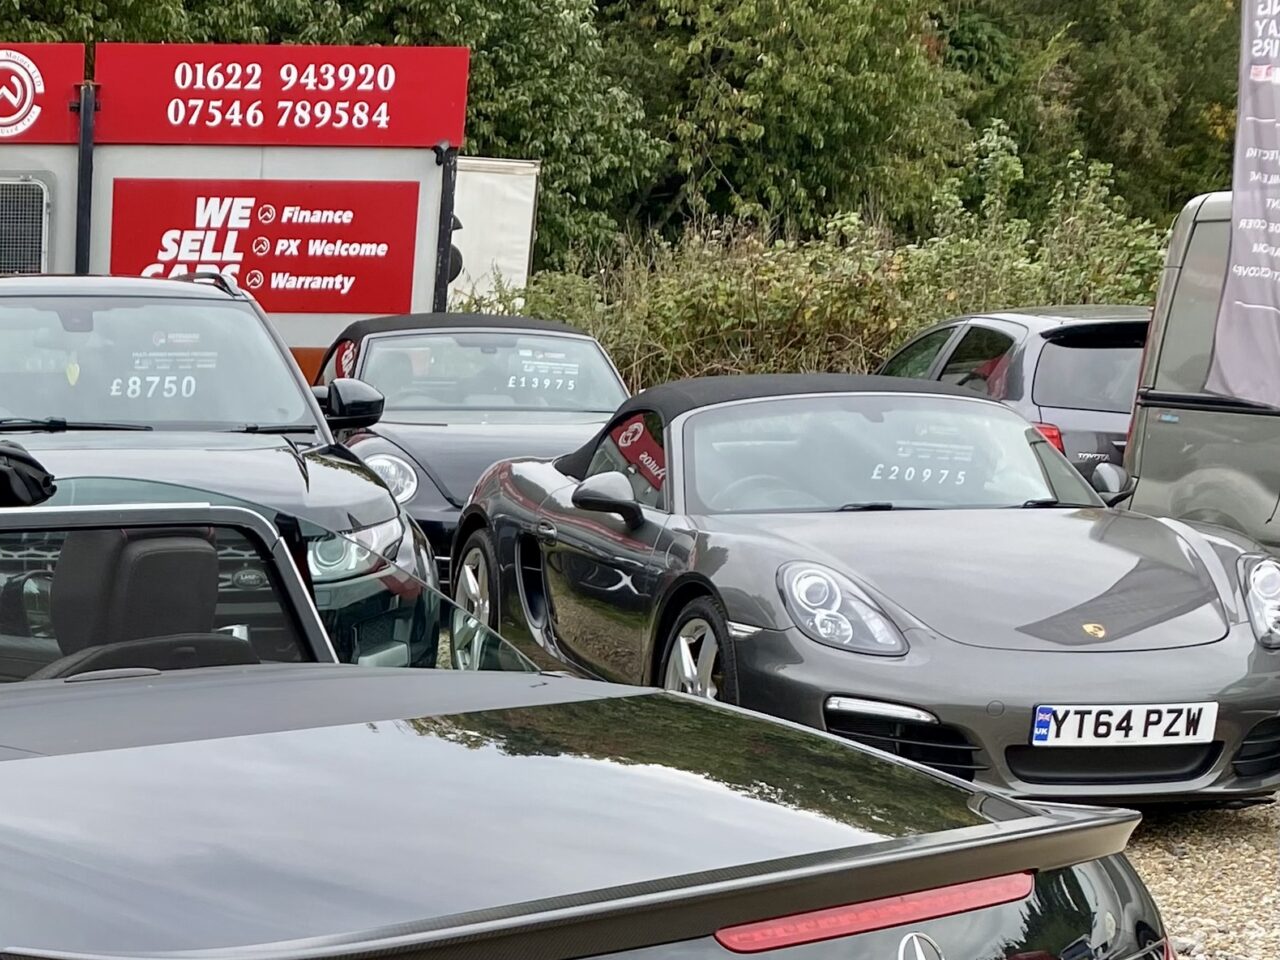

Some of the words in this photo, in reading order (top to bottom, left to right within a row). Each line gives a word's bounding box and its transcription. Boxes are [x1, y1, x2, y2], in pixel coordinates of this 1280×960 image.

[175, 63, 261, 89] 01622
[280, 64, 395, 90] 943920
[168, 99, 263, 127] 07546
[278, 101, 389, 128] 789584
[195, 197, 255, 228] WE
[282, 207, 353, 223] Finance
[156, 230, 244, 262] SELL
[275, 240, 301, 255] PX
[308, 240, 388, 256] Welcome
[271, 273, 355, 294] Warranty
[110, 376, 196, 398] £8750
[508, 376, 575, 390] £13975
[871, 463, 966, 485] £20975
[1035, 727, 1048, 735] UK
[1052, 709, 1133, 738] YT64
[1142, 707, 1203, 738] PZW
